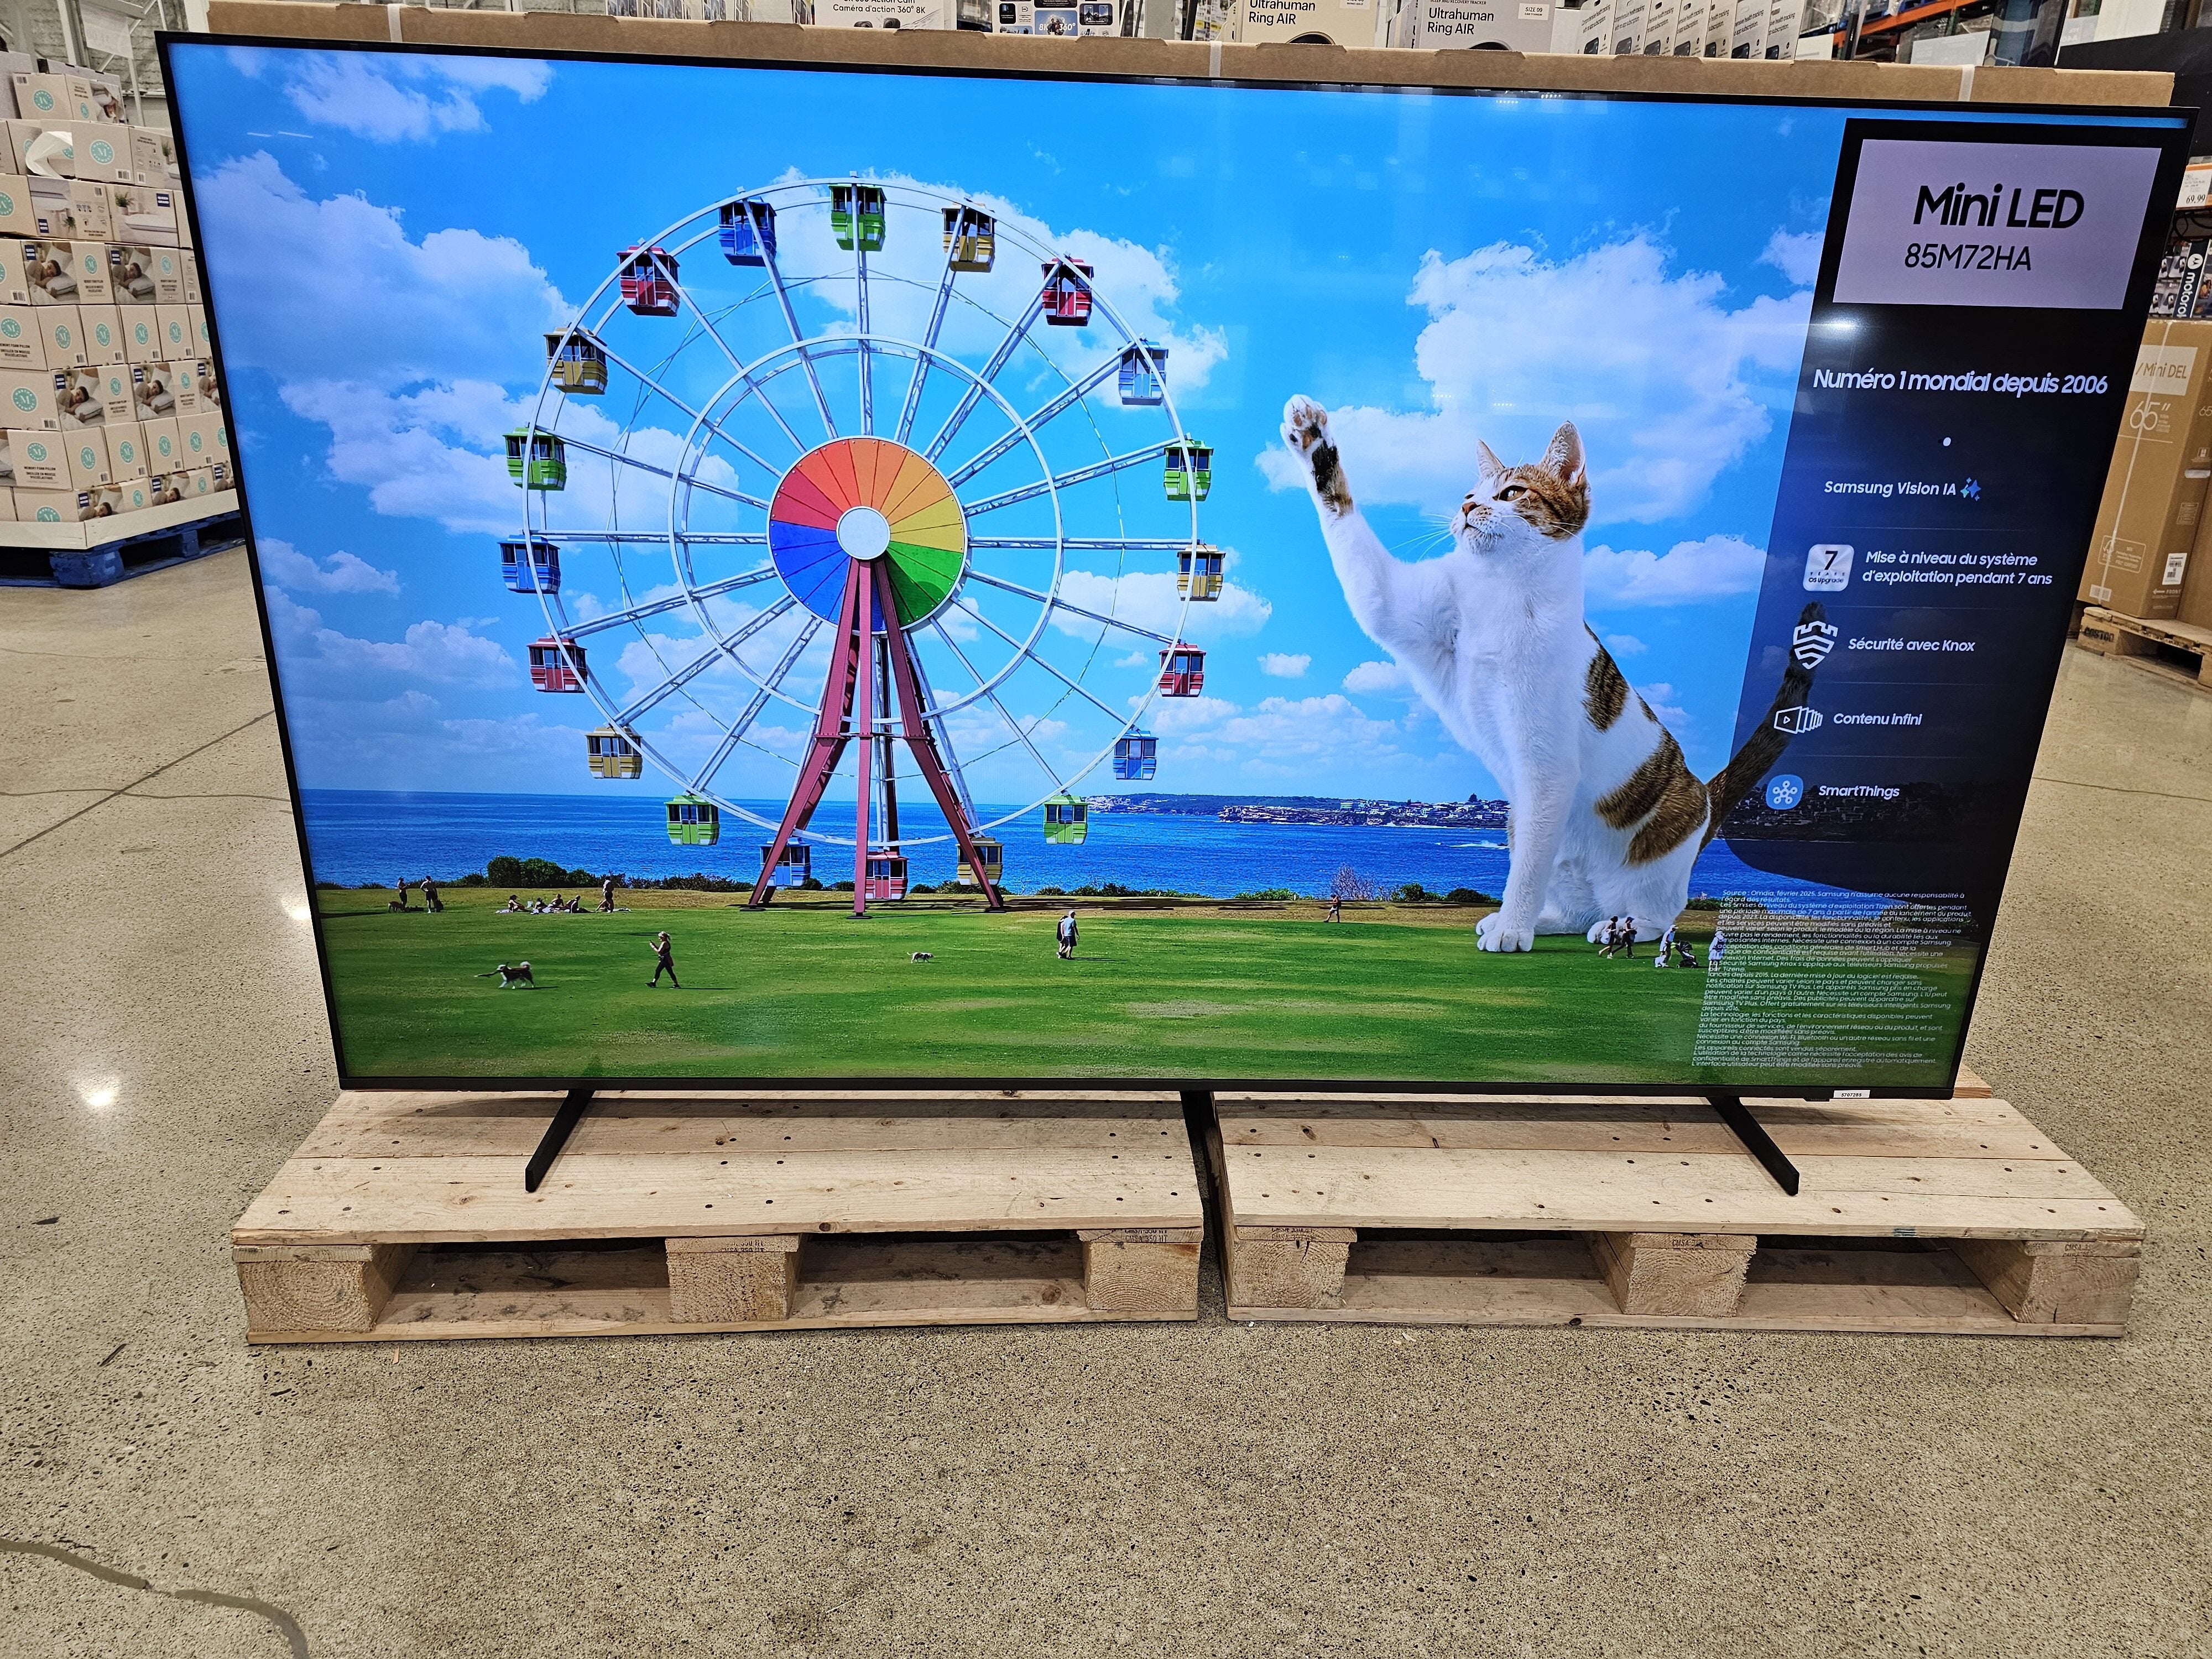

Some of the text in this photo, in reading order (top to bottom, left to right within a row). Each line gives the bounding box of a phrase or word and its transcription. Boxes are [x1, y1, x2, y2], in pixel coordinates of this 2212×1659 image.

[1250, 0, 1316, 11] Ultrahuman
[1249, 12, 1296, 25] Ring AIR
[1429, 7, 1494, 22] Ultrahuman
[1427, 22, 1474, 36] Ring AIR
[1913, 182, 2085, 229] Mini LED
[2186, 194, 2205, 204] 69.99
[1905, 243, 2031, 271] 85M72HA
[2177, 272, 2195, 317] motorol
[2143, 363, 2167, 377] Mini
[2168, 364, 2187, 379] DEL
[1813, 367, 2108, 398] Numéro 1 mondial depuis 2006
[1824, 480, 1956, 497] Samsung Vision IA
[1824, 550, 1838, 570] 7
[1866, 550, 2038, 568] Mise à niveau du système
[1863, 570, 2052, 586] d'exploitation pendant 7 ans
[1848, 637, 1975, 652] Sécurité avec Knox
[1833, 713, 1923, 726] Contenu infini
[1819, 785, 1900, 800] SmartThings
